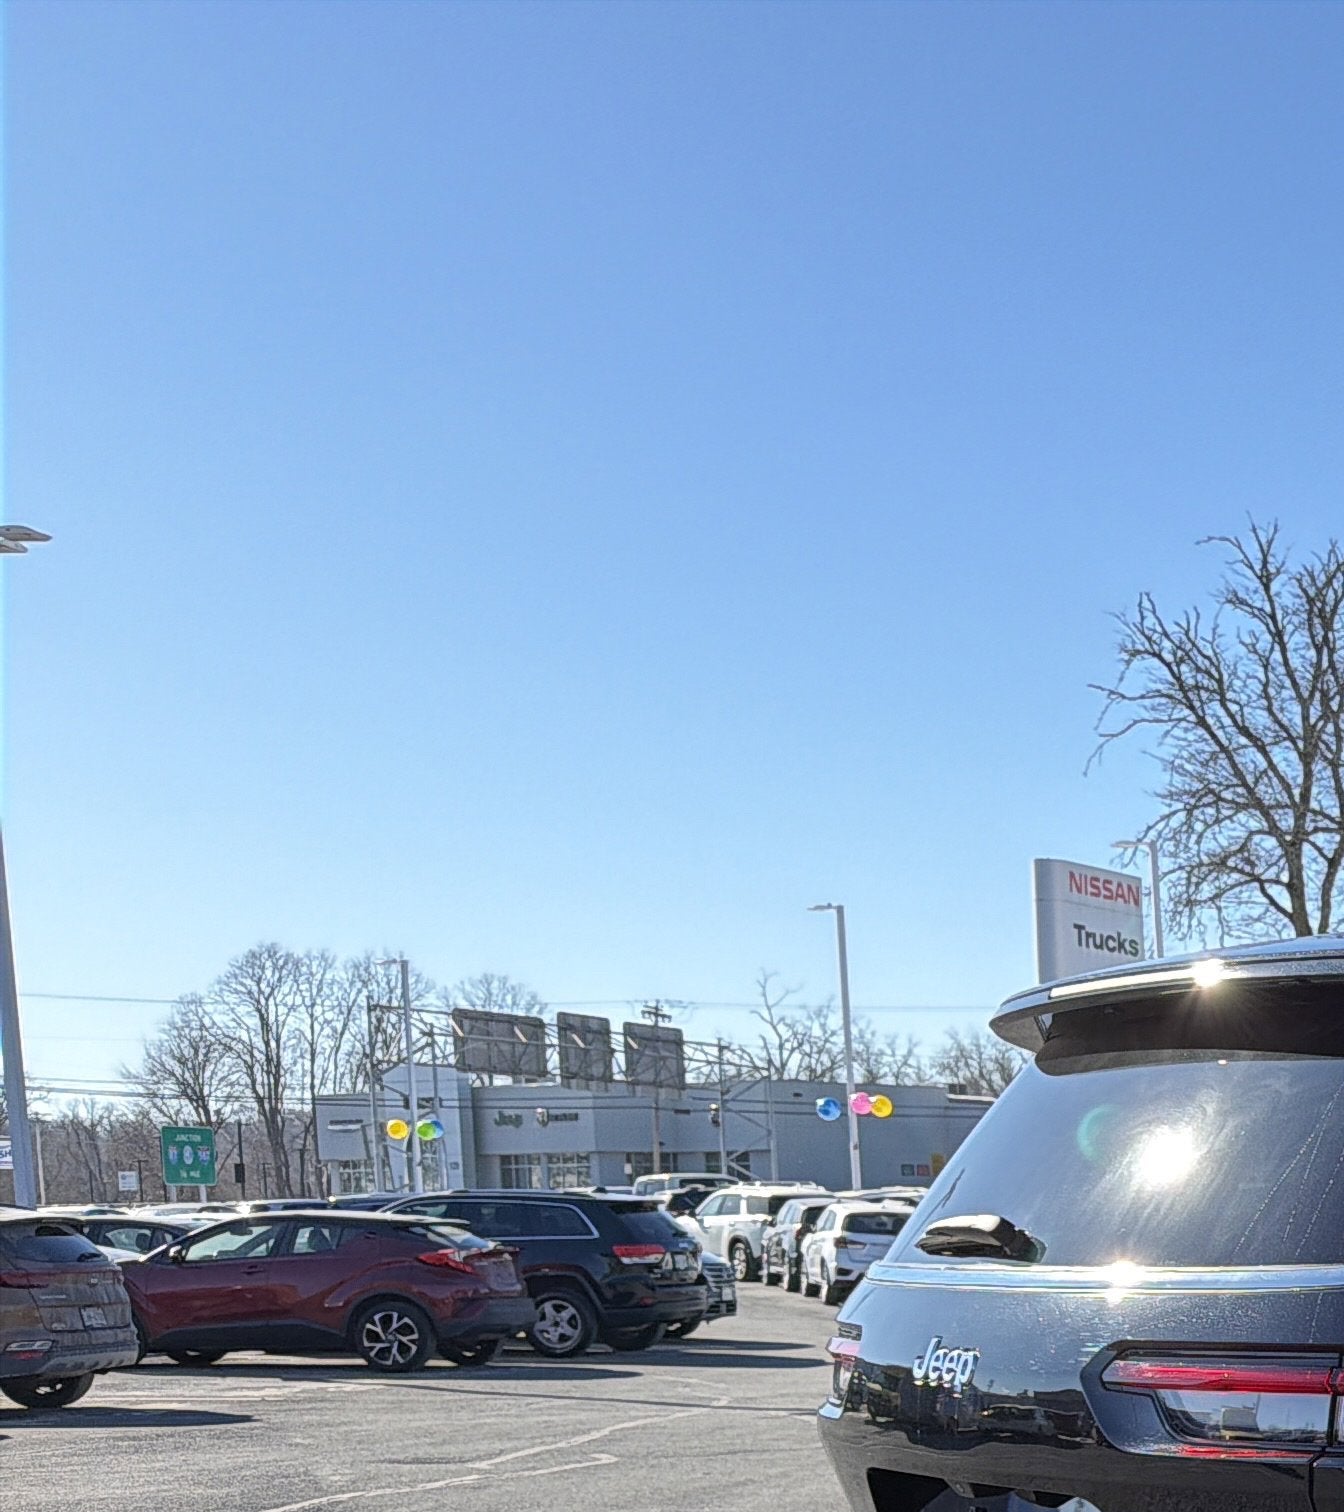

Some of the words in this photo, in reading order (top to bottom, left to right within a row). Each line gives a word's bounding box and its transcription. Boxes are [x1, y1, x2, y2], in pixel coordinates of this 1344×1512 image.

[1068, 870, 1140, 908] NISSAN
[1073, 922, 1139, 957] Trucks
[912, 1335, 980, 1393] Jeep
